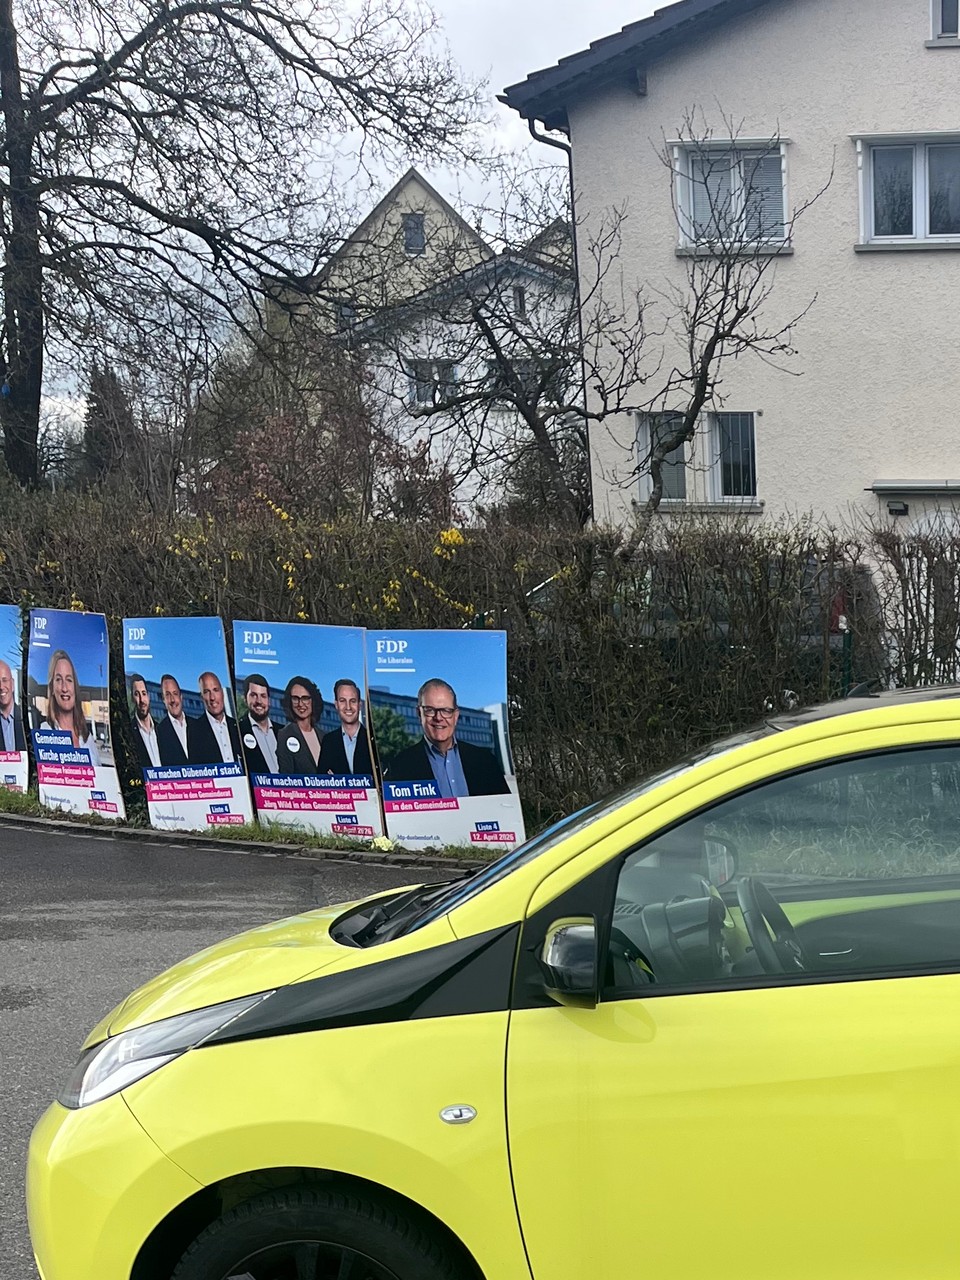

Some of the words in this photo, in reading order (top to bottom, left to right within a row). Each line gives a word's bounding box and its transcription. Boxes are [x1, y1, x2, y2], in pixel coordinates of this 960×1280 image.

[34, 617, 47, 629] FDP
[129, 628, 146, 640] FDP
[243, 631, 272, 645] FDP
[376, 640, 408, 653] FDP
[35, 732, 72, 745] Gemeinsam
[38, 749, 59, 761] Kirche
[59, 751, 90, 764] gestalten
[147, 769, 158, 779] Wir
[158, 768, 181, 778] machen
[181, 766, 218, 777] Dübendorf
[220, 764, 241, 775] stark
[257, 775, 271, 786] Wir
[273, 777, 304, 786] machen
[305, 776, 347, 787] Dübendorf
[348, 777, 370, 787] stark
[260, 789, 280, 798] Stefan
[309, 790, 330, 799] Sabine
[331, 791, 351, 799] Meier
[352, 791, 365, 799] und
[389, 785, 411, 797] Tom
[413, 783, 436, 796] Fink
[278, 800, 292, 809] Wild
[300, 801, 312, 809] den
[313, 802, 353, 810] Gemeinderat
[401, 802, 413, 810] den
[414, 801, 457, 810] Gemeinderat
[478, 823, 492, 831] Liste
[472, 833, 482, 841] 12.
[484, 833, 498, 841] April
[499, 833, 515, 841] 2026
